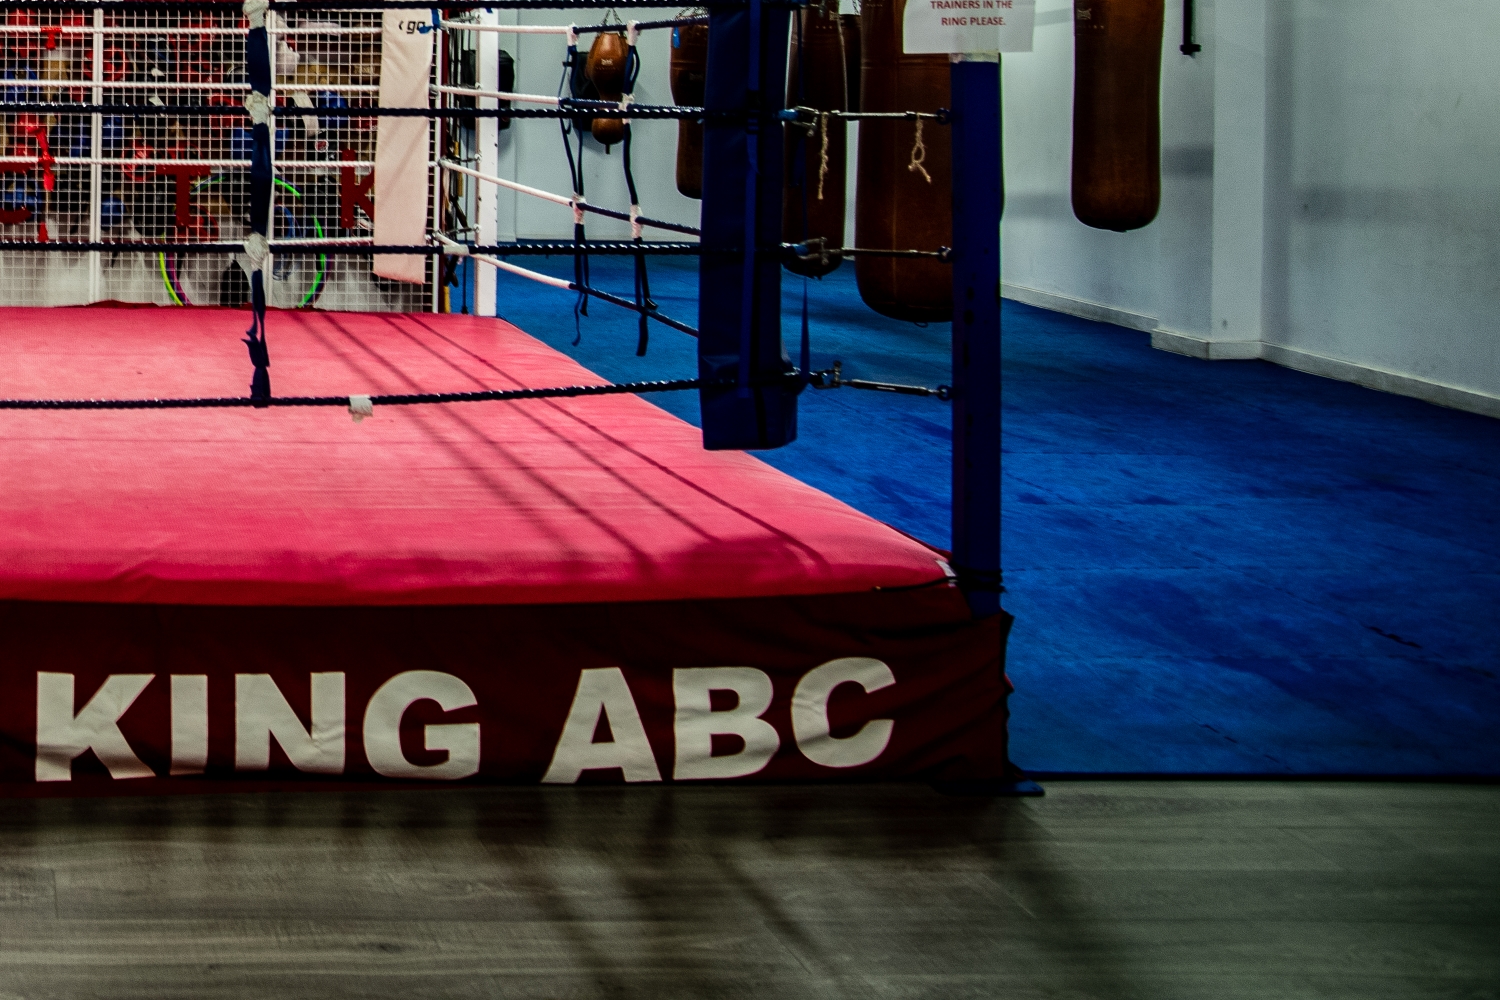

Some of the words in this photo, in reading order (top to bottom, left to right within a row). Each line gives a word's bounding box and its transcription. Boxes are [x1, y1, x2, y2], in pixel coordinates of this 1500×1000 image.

[930, 0, 981, 10] TRAINERS
[982, 0, 994, 9] IN
[996, 0, 1013, 9] THE
[941, 16, 967, 26] RING
[970, 16, 1006, 26] PLEASE.
[35, 669, 481, 782] KING
[541, 656, 897, 784] ABC
